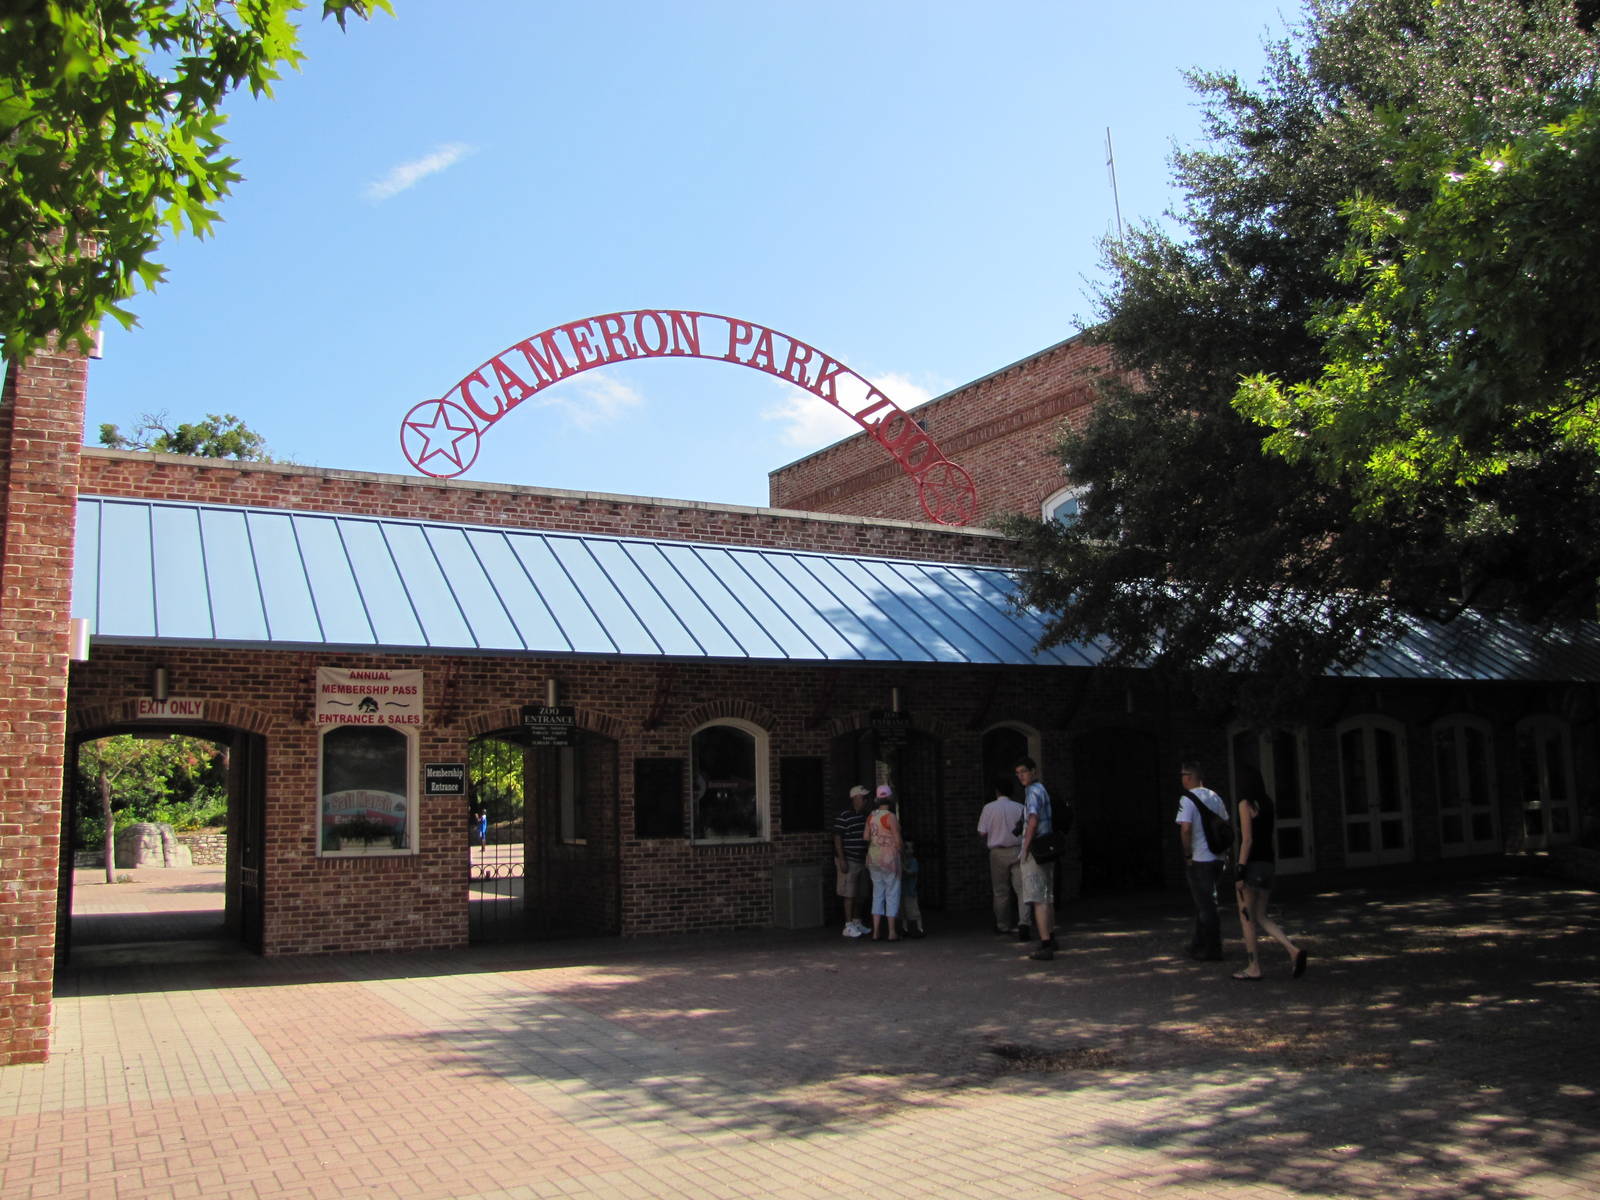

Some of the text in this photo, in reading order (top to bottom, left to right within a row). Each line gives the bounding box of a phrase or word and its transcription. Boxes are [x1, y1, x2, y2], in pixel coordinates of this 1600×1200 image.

[460, 309, 934, 472] CAMERON PARK ZOO
[349, 671, 391, 681] ANNUAL
[322, 684, 417, 695] MEMBERSHIP PASS
[140, 700, 202, 715] EXIT ONLY
[539, 707, 560, 715] ZOO
[319, 714, 420, 724] ENTRANCE & SALES
[524, 715, 574, 723] ENTRANCE
[427, 767, 464, 780] Membership
[431, 782, 459, 791] Entrance
